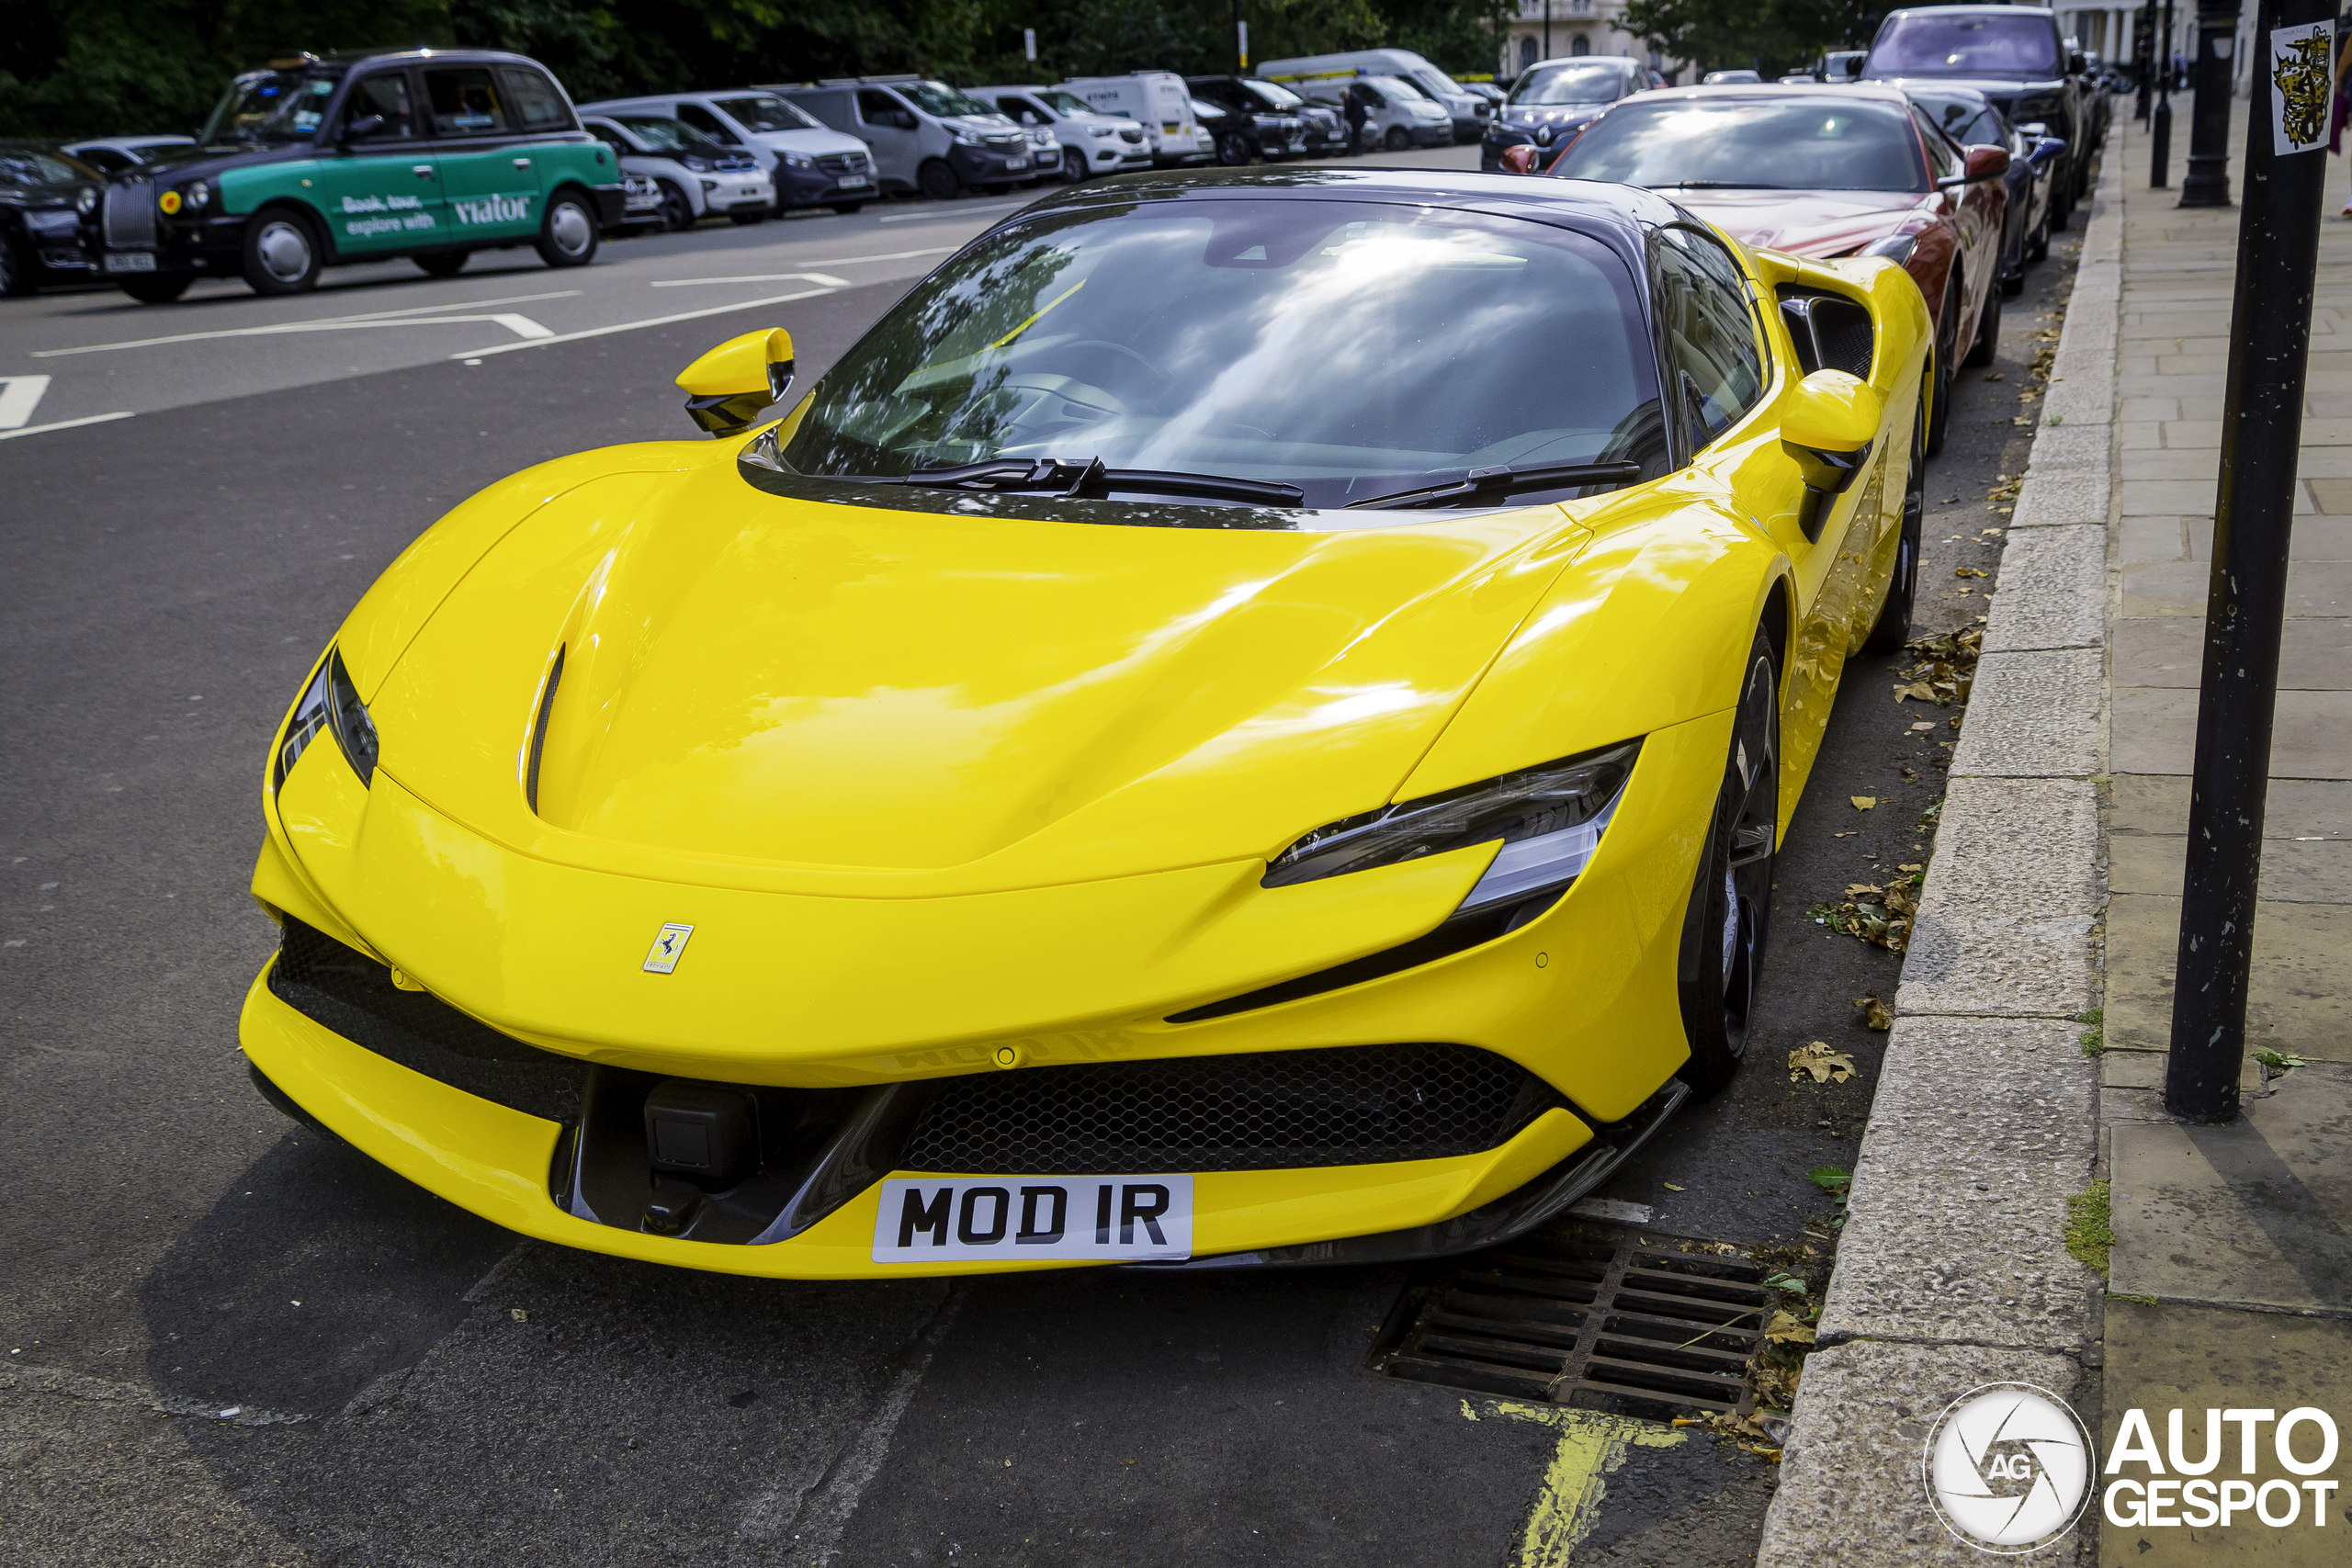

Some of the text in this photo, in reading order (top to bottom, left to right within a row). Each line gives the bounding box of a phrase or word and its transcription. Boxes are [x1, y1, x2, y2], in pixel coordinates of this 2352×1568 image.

[342, 194, 423, 213] Book, tour,
[455, 193, 530, 225] viator
[346, 212, 435, 238] explore with
[898, 1185, 1068, 1247] MOD
